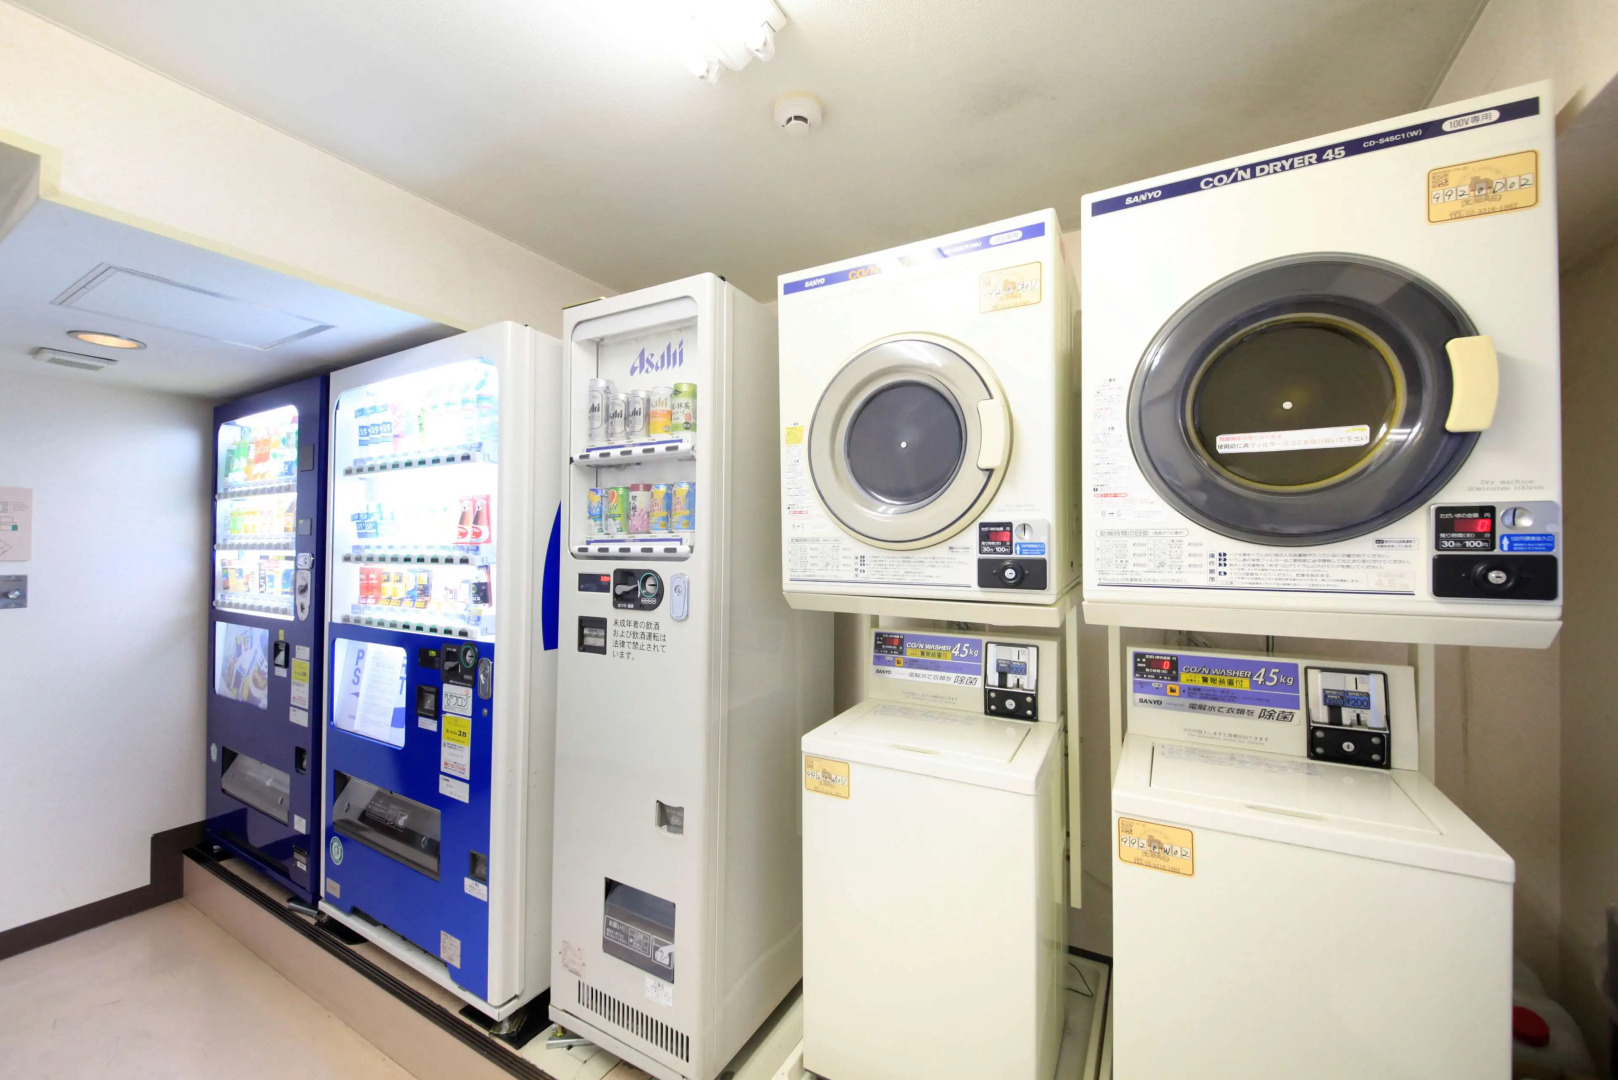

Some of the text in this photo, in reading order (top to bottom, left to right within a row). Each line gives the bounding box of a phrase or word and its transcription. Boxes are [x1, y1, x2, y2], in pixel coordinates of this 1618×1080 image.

[1449, 112, 1492, 129] 100V専用
[1124, 190, 1162, 205] SANYO
[1255, 153, 1317, 178] DRYER
[1322, 146, 1346, 161] 45
[804, 277, 826, 288] SANYO
[629, 338, 684, 377] Asahi
[613, 619, 660, 631] 未成年者の飲酒
[613, 629, 667, 642] および飲酒運転は
[612, 640, 666, 653] 法律で禁止されて
[925, 643, 951, 651] WASHER
[355, 649, 366, 666] P
[612, 651, 635, 661] います。
[1163, 661, 1171, 670] 0
[352, 668, 362, 686] S
[1212, 668, 1252, 678] WASHER
[953, 675, 978, 686] 除菌
[1138, 697, 1163, 706] SANYO
[1188, 703, 1296, 722] 電解水で衣類を 除菌
